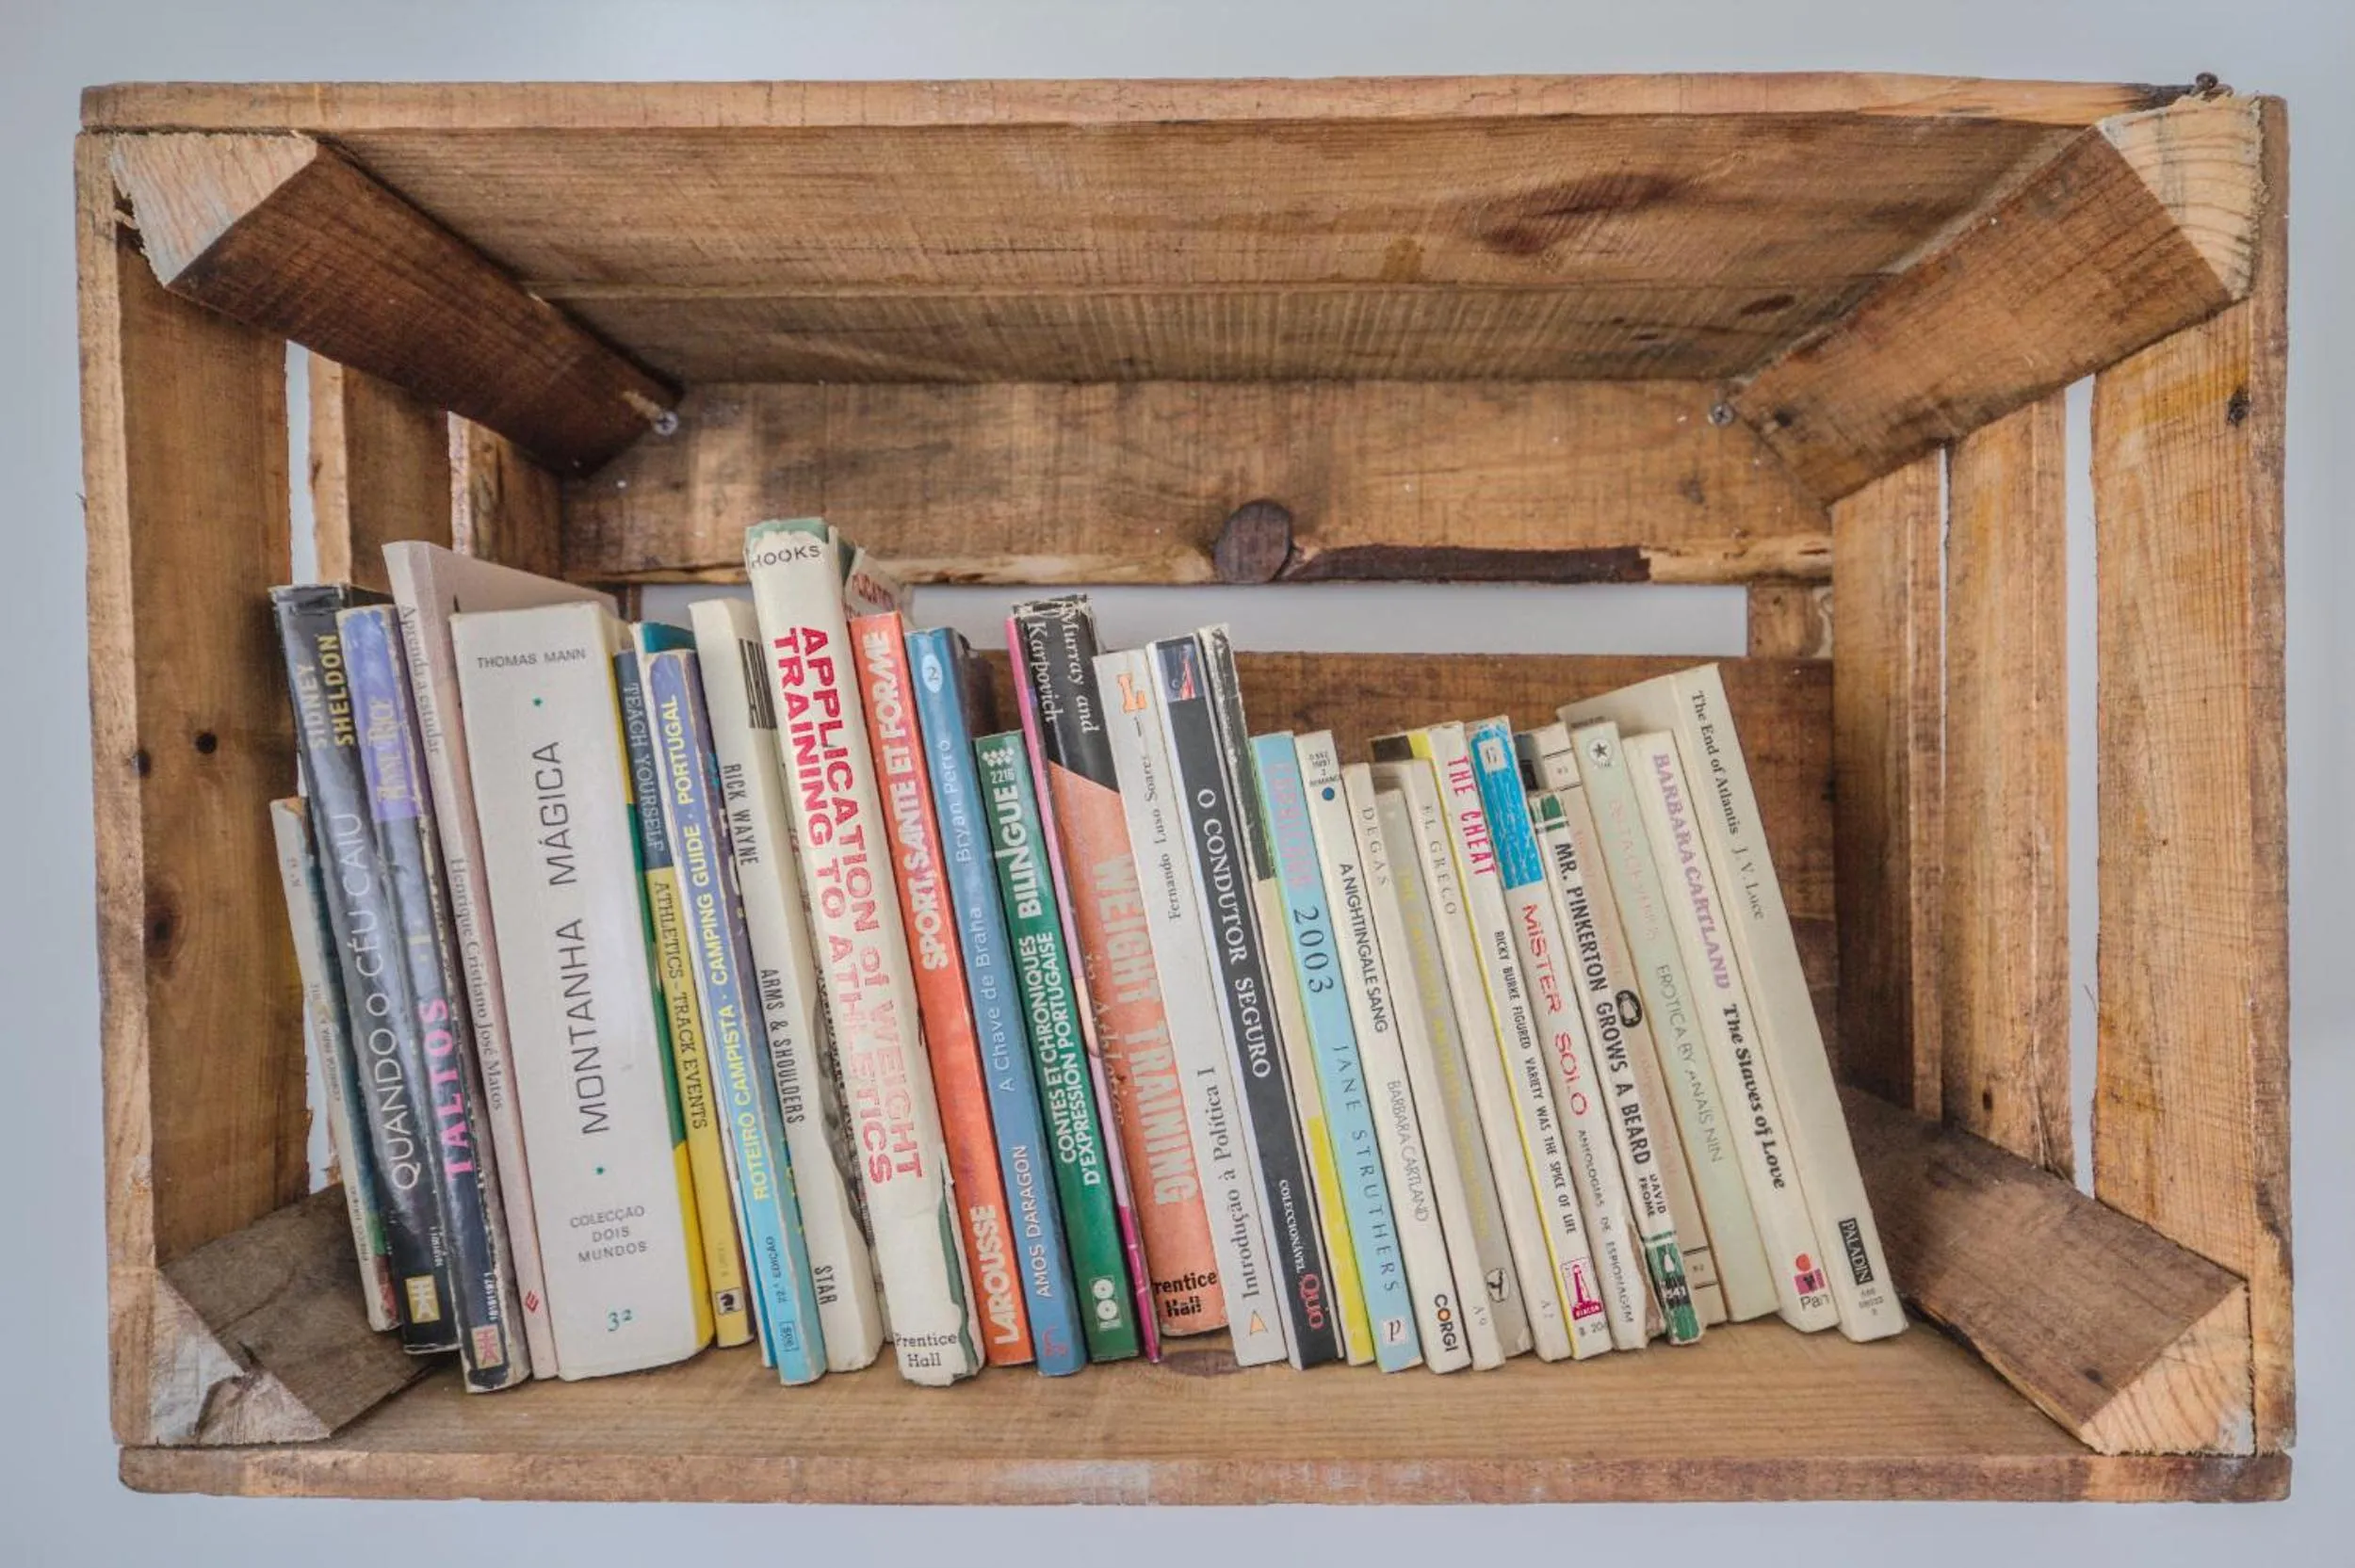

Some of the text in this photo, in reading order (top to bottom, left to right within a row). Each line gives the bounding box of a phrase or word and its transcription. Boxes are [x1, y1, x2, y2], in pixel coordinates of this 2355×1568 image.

[297, 635, 353, 749] SIDNEY SHELDON
[401, 605, 425, 680] Aprenda
[417, 694, 443, 754] estudar
[477, 648, 587, 669] THOMAS MANN
[1028, 621, 1063, 723] Karpovich
[1076, 695, 1100, 734] and
[1692, 690, 1707, 722] The
[1698, 723, 1718, 754] End
[624, 682, 664, 850] TEACH YOURSELF
[773, 627, 833, 846] TRAINING
[817, 858, 846, 918] TO
[937, 739, 972, 863] Bryan Perro
[1710, 757, 1725, 773] of
[1715, 776, 1738, 835] Atlantis
[723, 763, 759, 866] RICK WAYNE
[993, 785, 1042, 919] BILINGUE
[1151, 809, 1169, 844] Luso
[1362, 808, 1389, 886] DEGAS
[1448, 756, 1495, 875] THE CHEAT
[801, 626, 879, 931] APPLICATION
[869, 999, 922, 1179] WEIGHT
[1153, 852, 1180, 919] Fernando
[1432, 841, 1456, 914] GRECO
[1554, 842, 1579, 881] MR.
[1652, 753, 1731, 989] BARBARA CARTLAND
[532, 741, 610, 1134] MONTANHA MÁGICA
[661, 695, 770, 1200] ROTEIRO CAMPISTA CAMPING GUIDE PORTUGAL
[1093, 855, 1161, 1003] WEIGHT
[1197, 789, 1271, 1078] O CONDUTOR SEGURO
[1293, 907, 1334, 994] 2003
[1339, 864, 1389, 1033] A NIGHTINGALE SANG
[1494, 930, 1508, 960] RICKY
[1566, 886, 1608, 993] PINKERTON
[333, 815, 421, 1190] QUANDO O CÉU CAIU
[450, 857, 502, 1110] Henrique Cristiano José Matos
[654, 882, 707, 1130] ATHLETICS TRACK EVENTS
[968, 907, 1015, 1091] A Chave de Braha
[1502, 966, 1519, 1001] BURKE
[760, 969, 804, 1124] ARMS & SHOULDERS
[1019, 935, 1076, 1164] CONTES ET CHRONIQUES
[1036, 931, 1100, 1187] D'EXPRESSION PORTUGAISE
[1514, 1006, 1532, 1049] FIGURED
[1596, 1002, 1630, 1074] GROWS
[1657, 965, 1687, 1040] EROTICA
[1678, 1043, 1696, 1065] BY
[1702, 1131, 1723, 1163] NIN
[417, 998, 474, 1182] TALTOS
[1125, 1020, 1198, 1205] TRAINING
[1523, 1057, 1544, 1100] VARIETY
[1535, 1106, 1552, 1131] WAS
[1616, 1083, 1634, 1096] A
[1723, 1004, 1786, 1190] The Slaves of Love
[1204, 1085, 1232, 1162] Política
[1388, 1080, 1428, 1221] BARBARA CARTLAND
[1543, 1135, 1558, 1158] THE
[1620, 1103, 1650, 1166] BEARD
[1333, 1045, 1401, 1293] JANE STRUTHERS
[1550, 1160, 1567, 1193] SPICE
[1639, 1177, 1656, 1219] FROME
[1649, 1173, 1666, 1215] DAVID
[569, 1204, 644, 1228] COLECÇÃO
[578, 1241, 647, 1262] MUNDOS
[592, 1226, 629, 1243] DOIS
[1012, 1144, 1053, 1297] AMOS DARAGON
[1225, 1188, 1259, 1300] Introdução
[1563, 1213, 1578, 1235] LIFE
[1578, 1130, 1634, 1323] ANTOLOGIAS DE ESPIONAGEM
[1842, 1219, 1872, 1283] PALADIN
[815, 1266, 837, 1305] STAR
[969, 1205, 1019, 1345] LAROUSSE
[1151, 1271, 1217, 1294] rentice
[1165, 1296, 1201, 1317] Hall
[1799, 1293, 1830, 1311] Pan
[907, 1352, 941, 1367] Hall
[1433, 1295, 1458, 1351] CORGI
